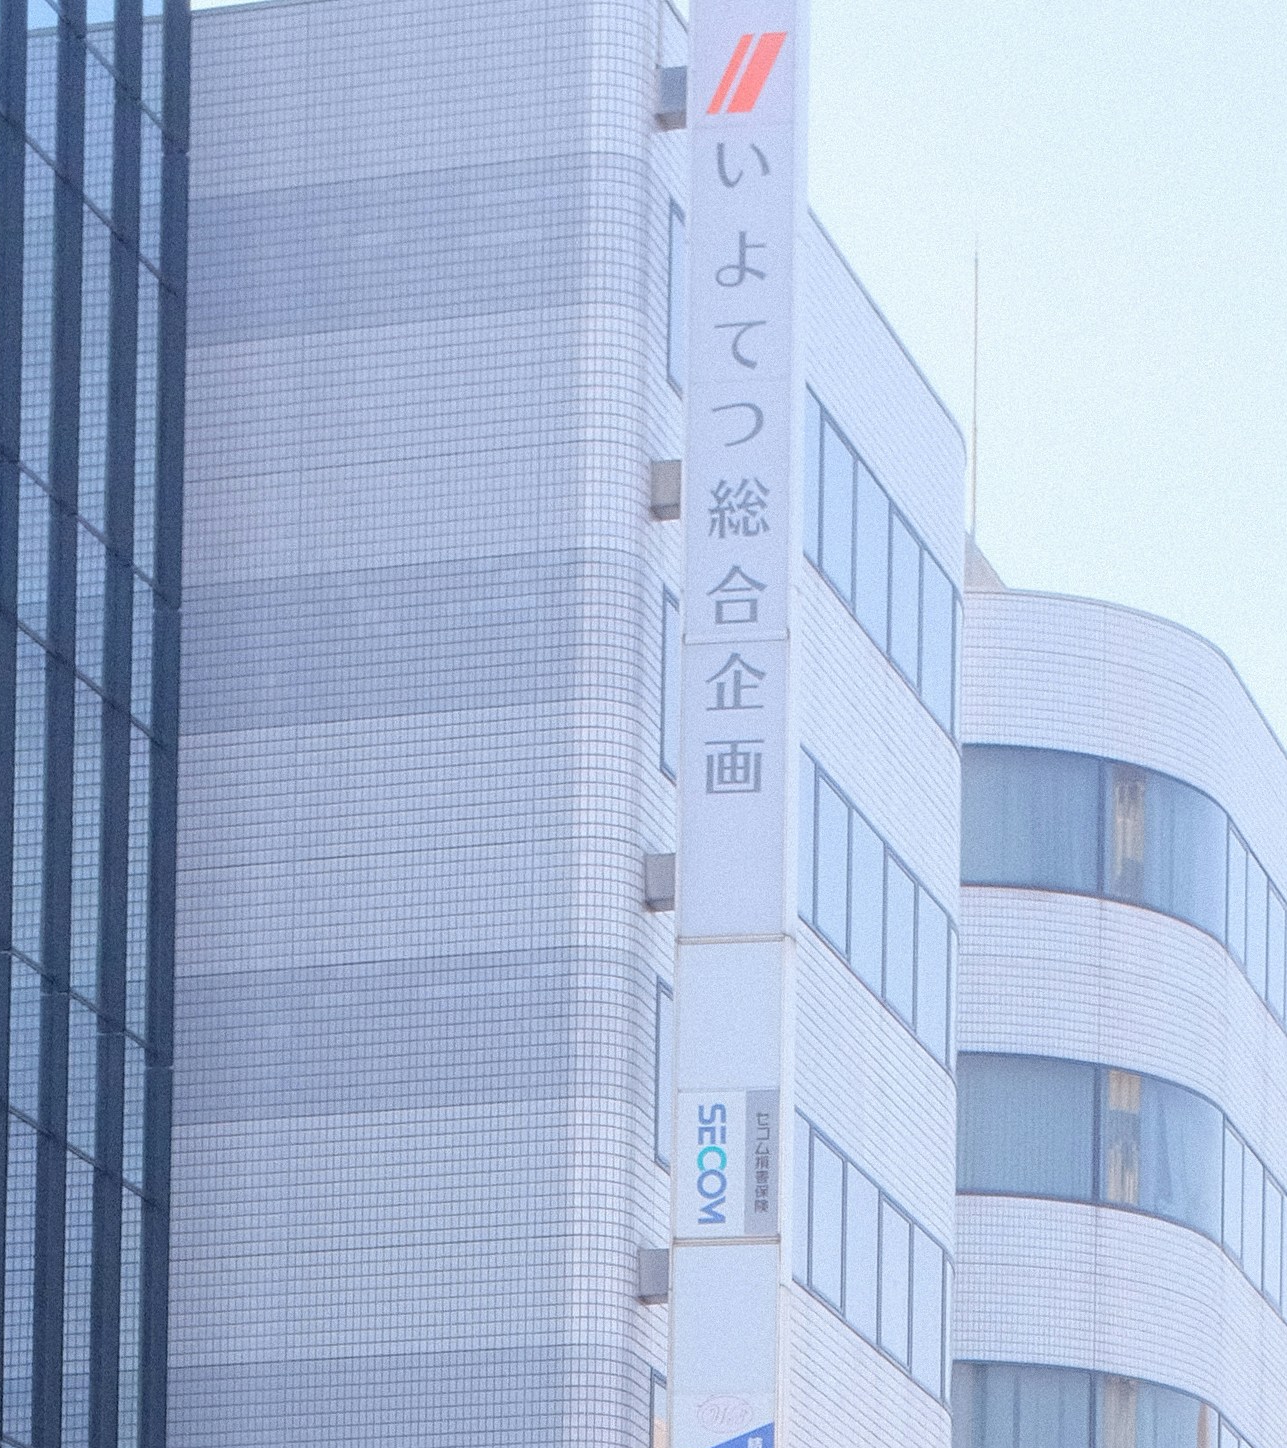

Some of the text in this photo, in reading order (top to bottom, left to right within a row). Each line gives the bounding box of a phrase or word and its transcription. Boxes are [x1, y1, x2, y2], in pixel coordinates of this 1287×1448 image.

[704, 141, 770, 797] いよてつ総合企画
[697, 1103, 727, 1225] SECOM
